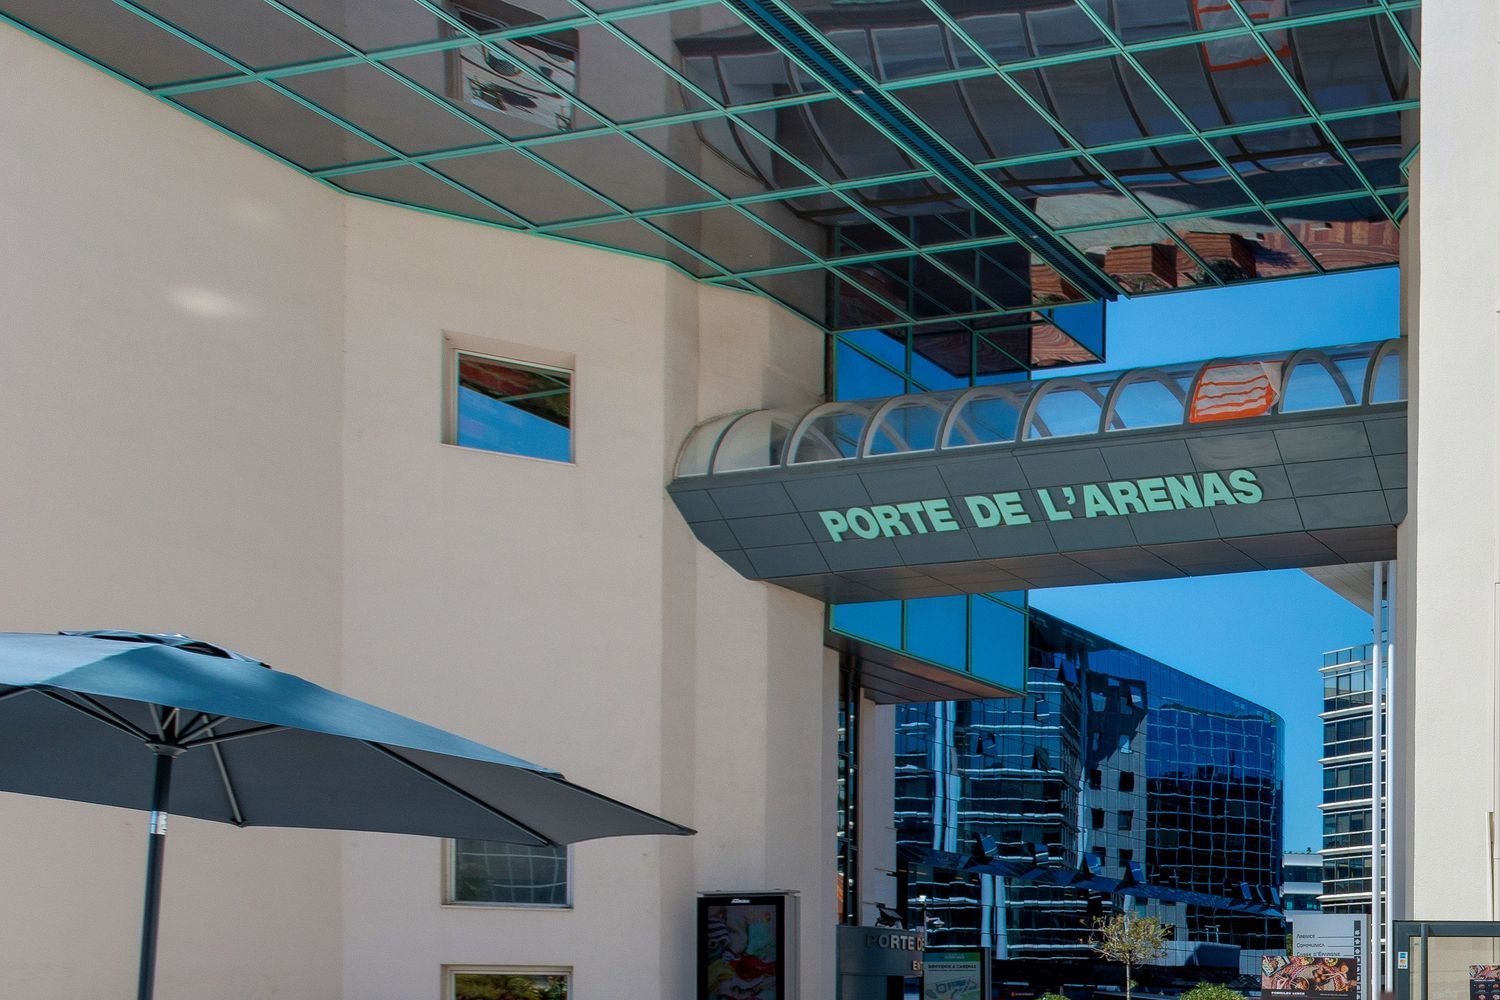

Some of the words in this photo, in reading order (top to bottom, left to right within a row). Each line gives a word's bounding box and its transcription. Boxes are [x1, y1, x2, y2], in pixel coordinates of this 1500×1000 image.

[818, 498, 960, 543] PORTE
[964, 491, 1032, 529] DE
[1037, 469, 1264, 521] L'ARENAS
[866, 934, 914, 951] PORTE
